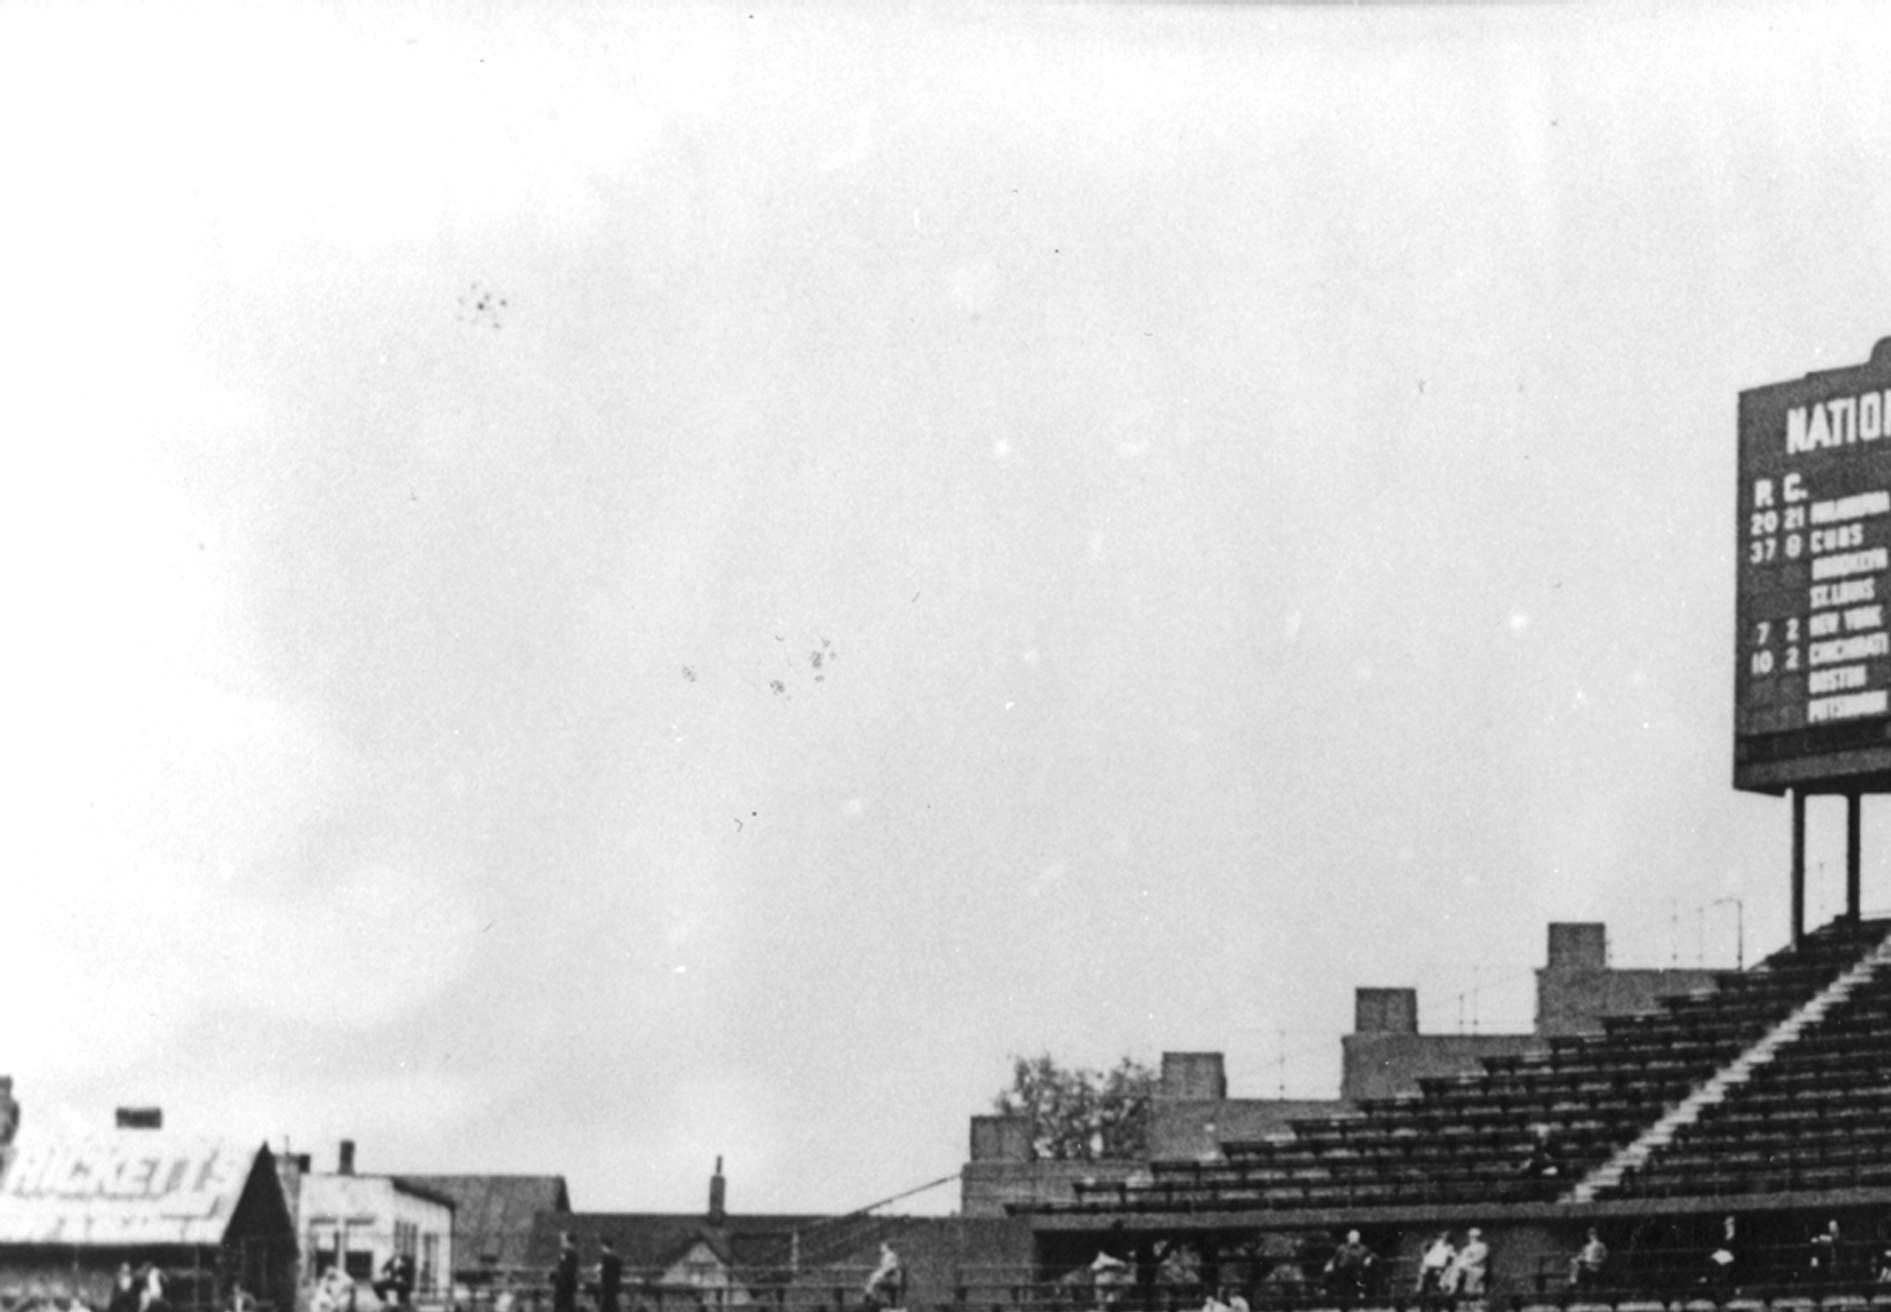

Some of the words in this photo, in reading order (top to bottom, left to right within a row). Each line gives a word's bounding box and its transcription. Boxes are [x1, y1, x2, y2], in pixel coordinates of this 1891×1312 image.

[1750, 537, 1776, 564] 37
[1810, 523, 1863, 553] CUBS
[1757, 621, 1771, 645] 7
[1786, 617, 1799, 641] 2
[1785, 646, 1799, 670] 2
